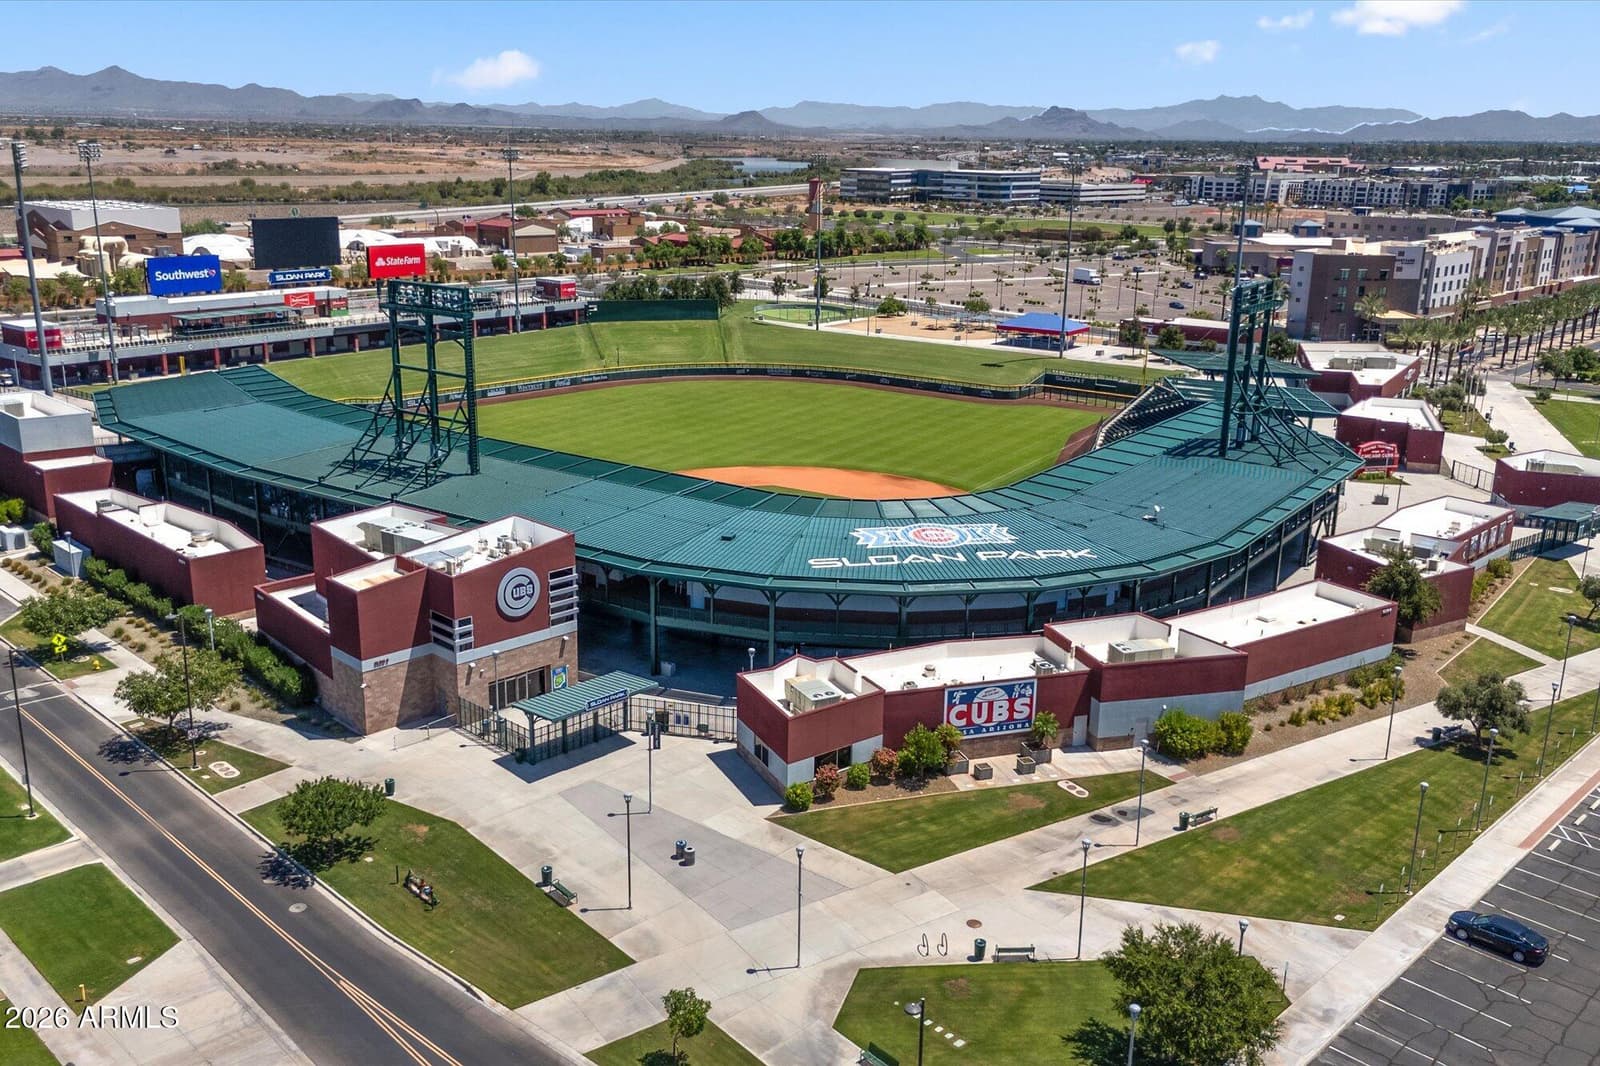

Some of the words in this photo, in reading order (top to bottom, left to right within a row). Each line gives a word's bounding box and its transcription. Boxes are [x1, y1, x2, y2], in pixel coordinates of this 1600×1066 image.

[155, 269, 209, 281] Southwest
[275, 273, 304, 281] SLOAN
[304, 271, 326, 279] PARK
[808, 552, 966, 568] SLOAN
[976, 549, 1097, 561] PARK
[504, 574, 535, 610] CUBS
[590, 696, 610, 706] SLOAN
[610, 692, 626, 701] PARK
[949, 697, 1031, 727] CUBS
